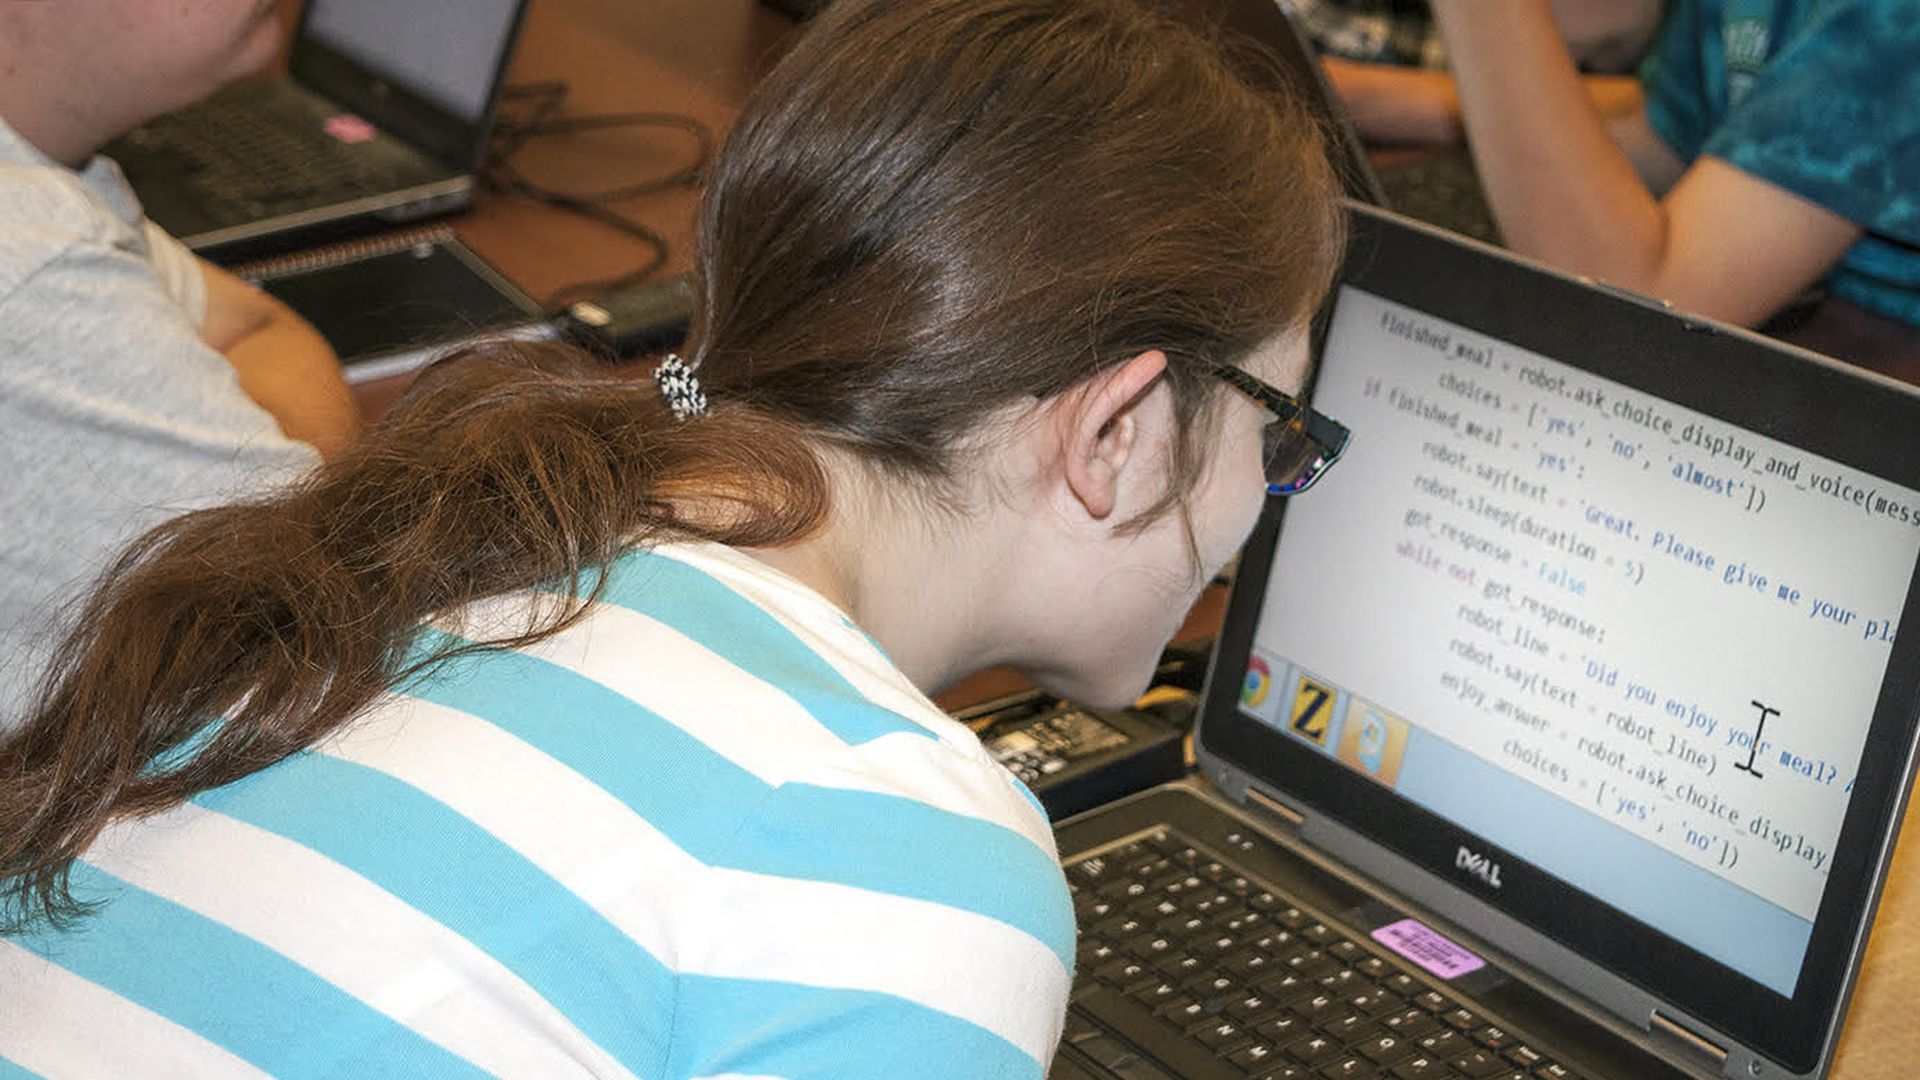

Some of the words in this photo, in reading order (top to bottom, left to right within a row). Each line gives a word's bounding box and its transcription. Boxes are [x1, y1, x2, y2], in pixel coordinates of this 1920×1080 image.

[1439, 371, 1502, 409] choices
[1395, 540, 1442, 571] while
[1449, 563, 1477, 587] not
[1539, 561, 1587, 597] False
[1652, 531, 1716, 572] Please
[1723, 561, 1768, 590] give
[1777, 584, 1800, 603] me
[1809, 598, 1857, 625] your
[1294, 684, 1329, 739] Z
[1448, 636, 1578, 709] robot.say(text
[1605, 709, 1717, 777] robot_line)
[1457, 603, 1550, 656] robot_line
[1625, 680, 1657, 706] you
[1664, 697, 1718, 738] enjoy
[1726, 724, 1771, 756] your
[1779, 751, 1837, 786] meal?
[1503, 737, 1570, 783] choices
[1455, 846, 1502, 889] DELL
